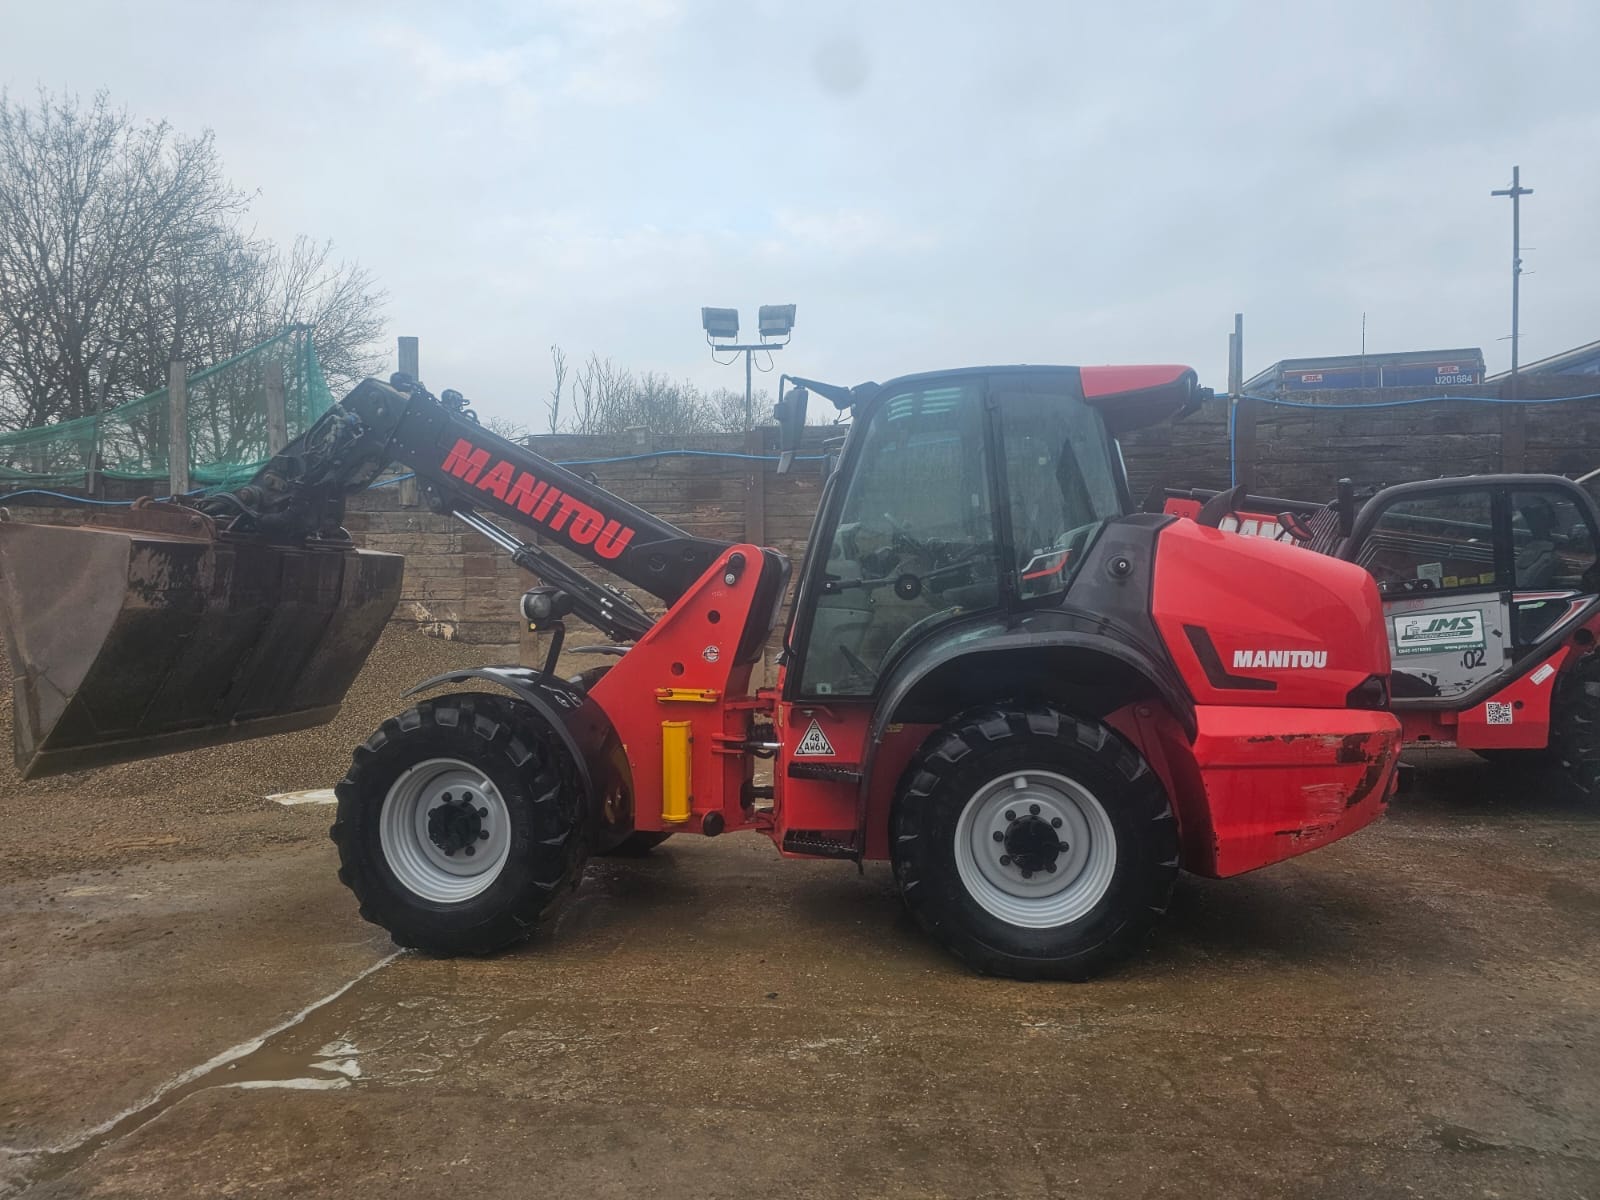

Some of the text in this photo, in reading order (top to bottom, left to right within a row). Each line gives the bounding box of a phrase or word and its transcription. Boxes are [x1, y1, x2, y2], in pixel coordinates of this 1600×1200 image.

[441, 438, 636, 559] MANITOU
[1422, 616, 1477, 633] JMS
[1233, 650, 1328, 668] MANITOU
[809, 733, 820, 742] 48
